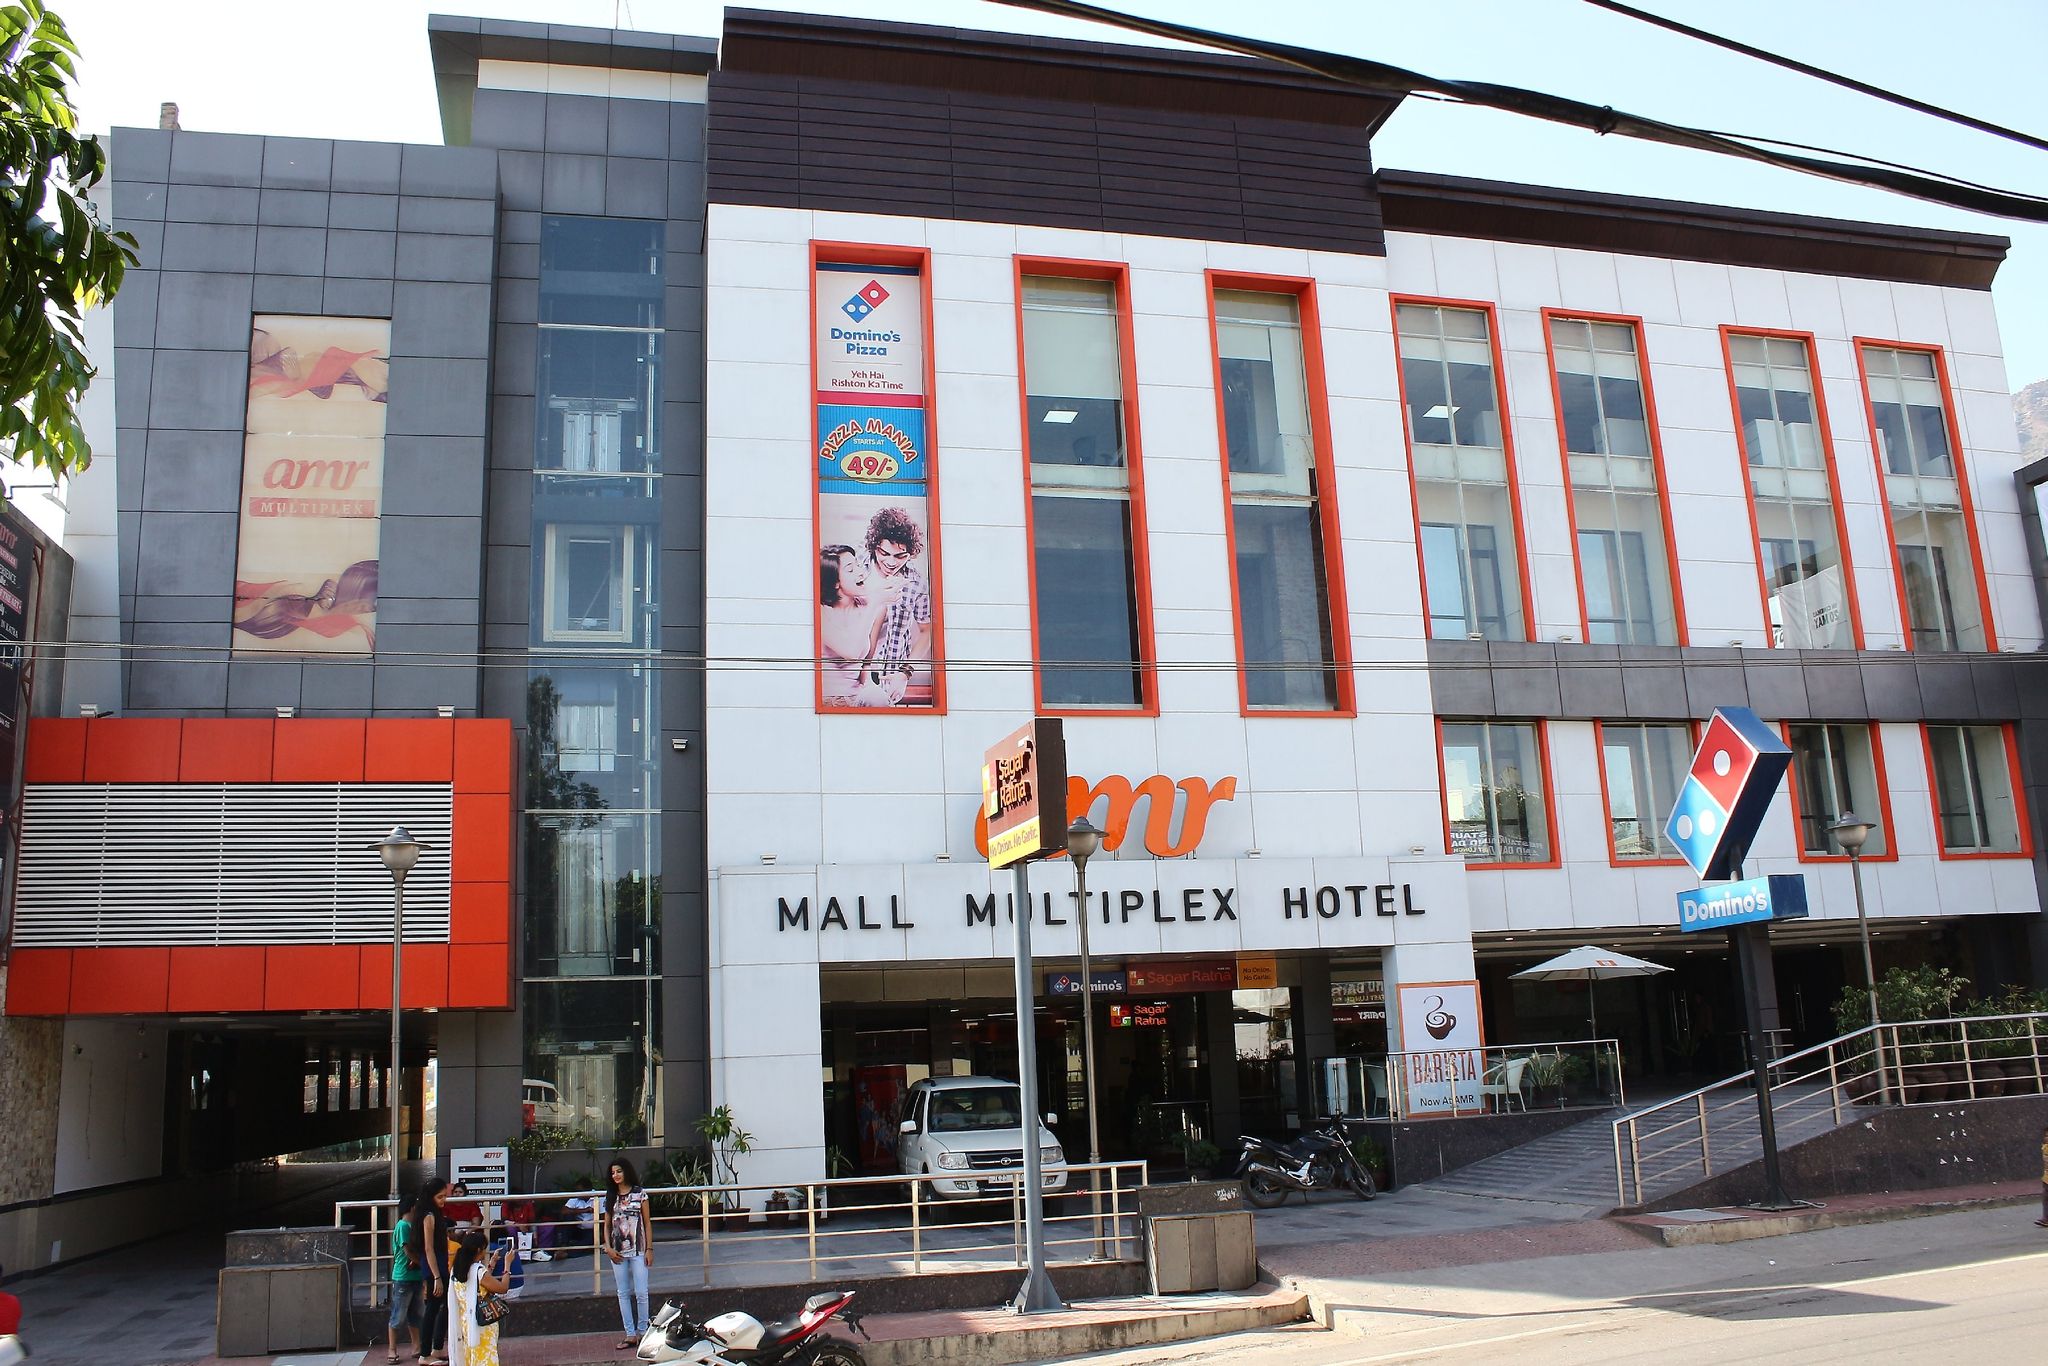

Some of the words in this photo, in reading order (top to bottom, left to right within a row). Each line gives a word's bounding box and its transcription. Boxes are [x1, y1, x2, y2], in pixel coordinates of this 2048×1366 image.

[830, 327, 901, 343] Domino's
[846, 343, 888, 356] Pizza
[851, 370, 868, 379] Yeh
[870, 371, 885, 379] Hai
[832, 379, 866, 388] Rishton
[868, 380, 880, 388] Ka
[882, 381, 904, 390] Time
[820, 420, 863, 461] PIZZA
[866, 418, 918, 463] MANIA
[263, 458, 370, 490] amr
[260, 502, 364, 515] MULTIPLEX
[998, 751, 1025, 780] Sagar
[1000, 781, 1026, 808] Ratna
[777, 894, 915, 932] MALL
[1283, 884, 1426, 919] HOTEL
[1682, 886, 1768, 923] Domino's
[1147, 970, 1190, 984] Sagar
[1192, 969, 1232, 983] Ratna
[1134, 1004, 1166, 1015] Sagar
[1134, 1016, 1166, 1026] Ratna
[1412, 1051, 1477, 1084] BARISTA
[1420, 1098, 1440, 1106] Now
[1455, 1094, 1474, 1104] AMR
